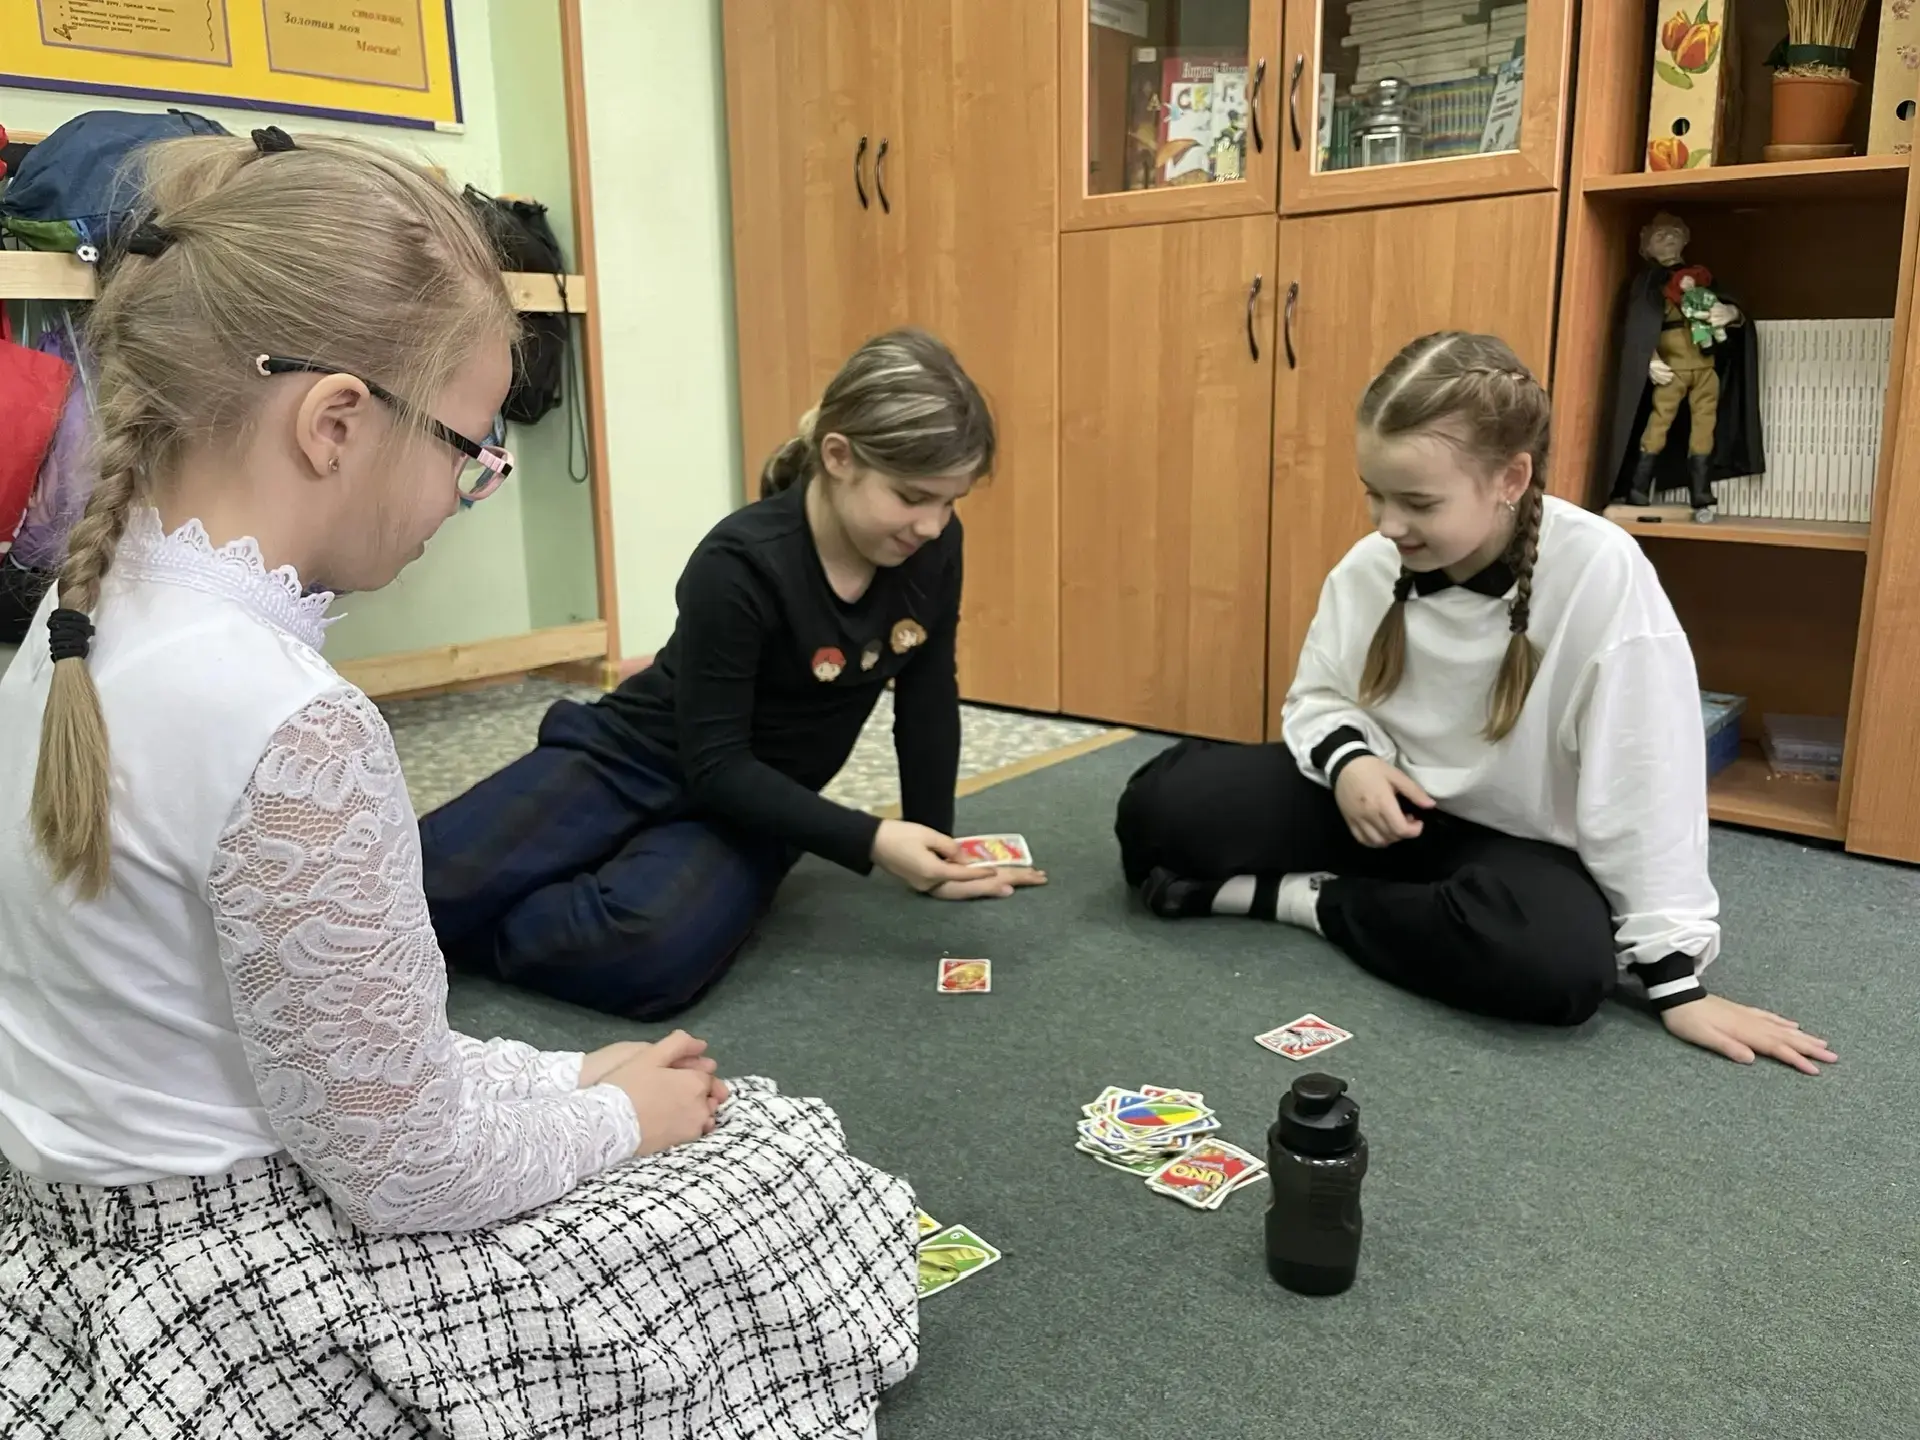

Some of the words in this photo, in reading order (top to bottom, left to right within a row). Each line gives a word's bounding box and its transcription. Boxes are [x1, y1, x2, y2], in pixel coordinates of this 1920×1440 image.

[284, 11, 335, 30] Золотая
[337, 23, 361, 34] моя
[1169, 1163, 1227, 1187] UNO
